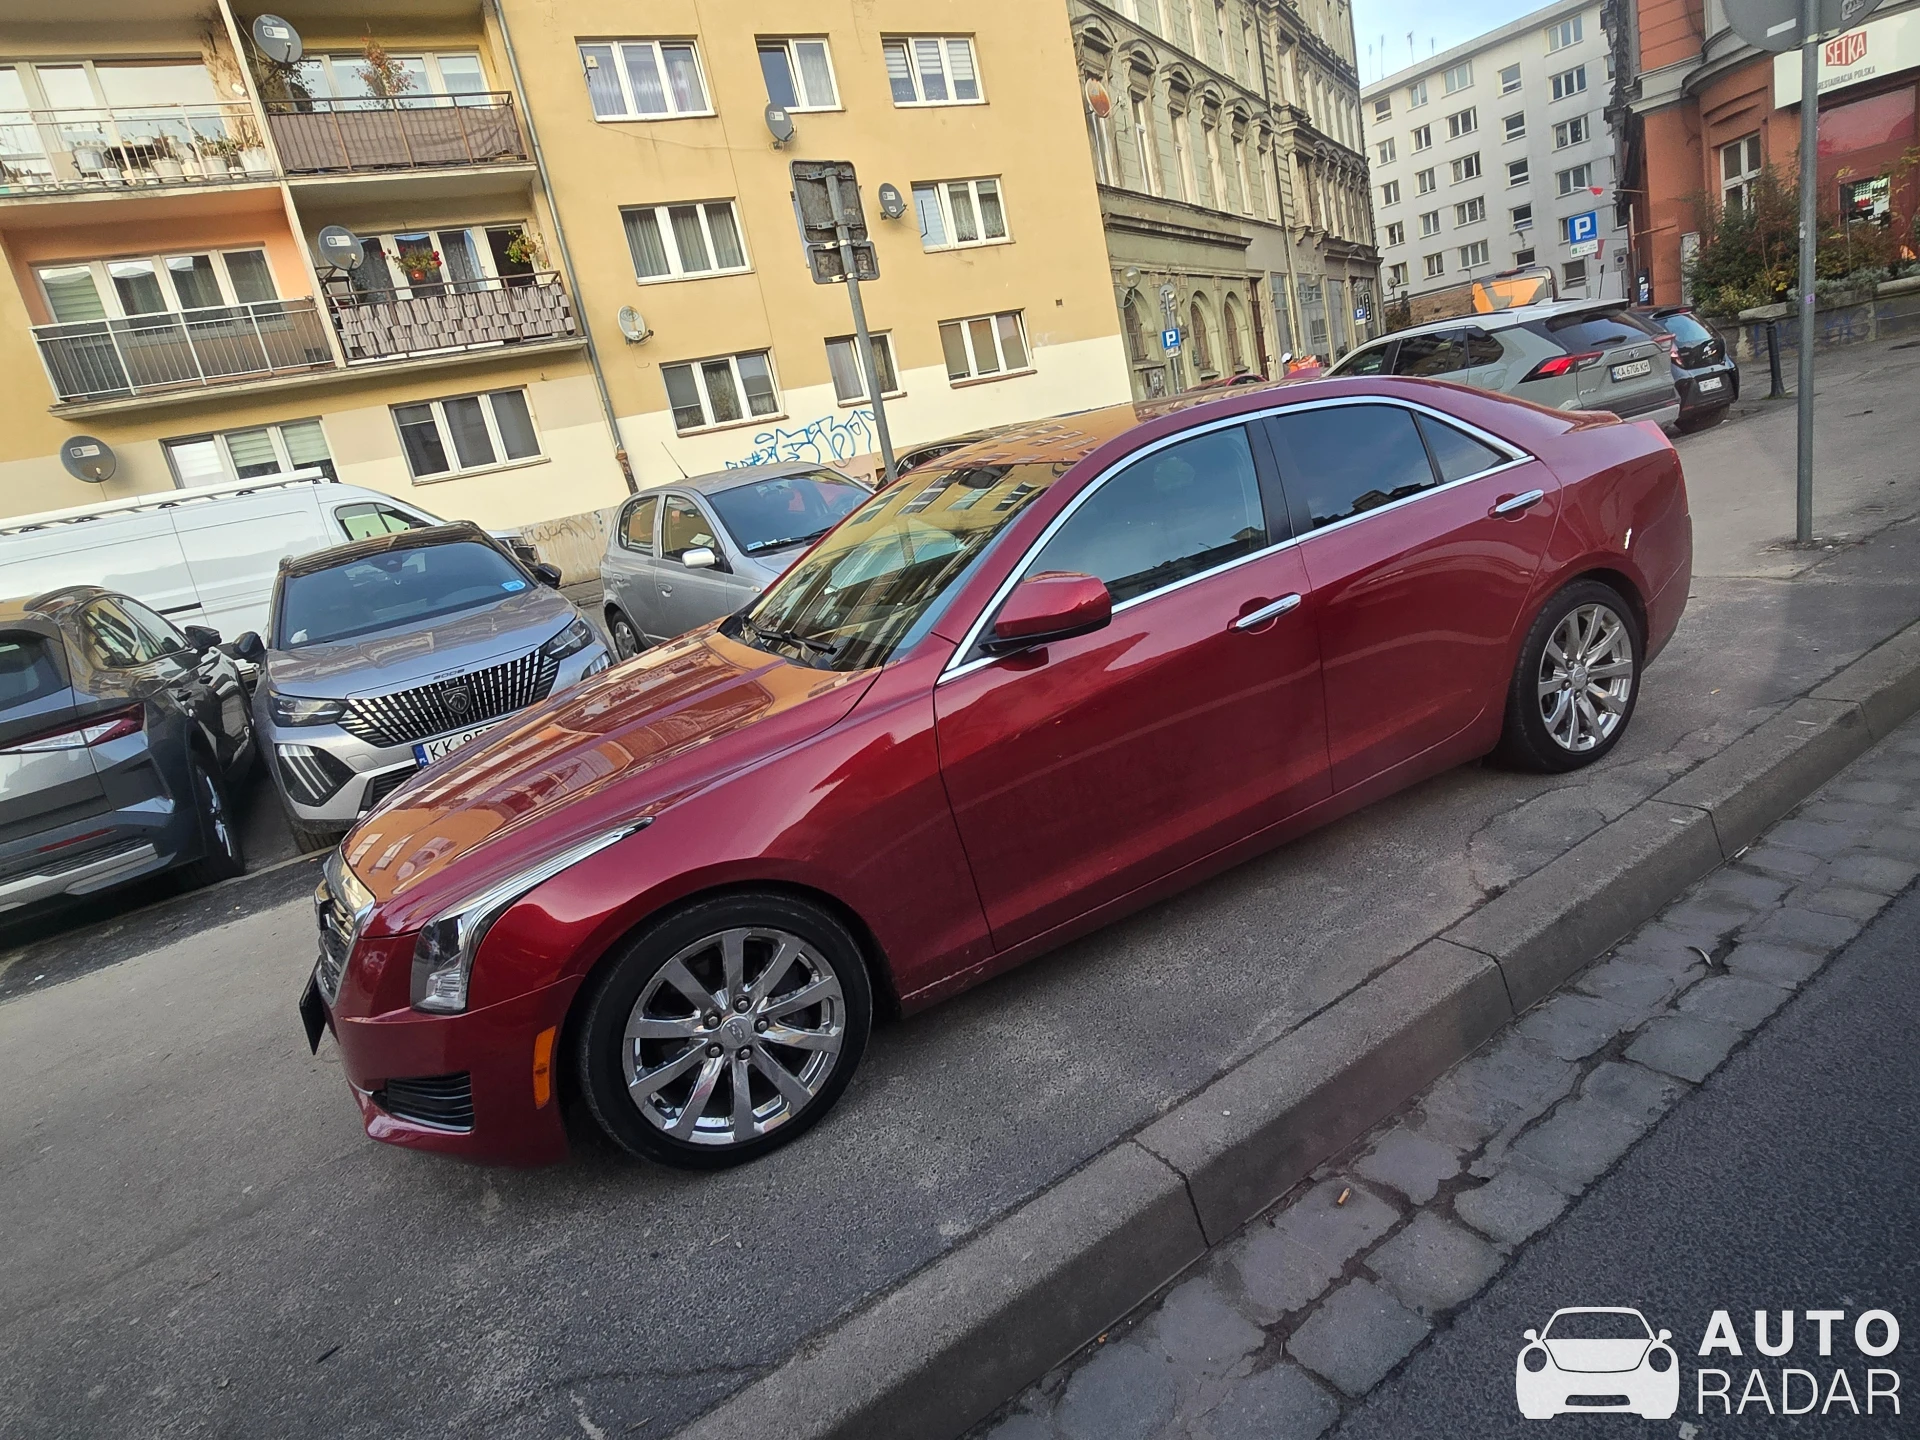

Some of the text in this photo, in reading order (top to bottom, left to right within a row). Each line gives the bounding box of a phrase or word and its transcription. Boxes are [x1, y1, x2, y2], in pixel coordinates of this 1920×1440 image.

[1827, 34, 1865, 65] SETKA
[1854, 65, 1876, 79] POLSKA
[1575, 216, 1591, 240] P
[1356, 309, 1363, 318] P
[1166, 331, 1177, 346] P
[1616, 367, 1626, 376] KA
[1640, 361, 1650, 371] KH
[429, 738, 453, 760] KK
